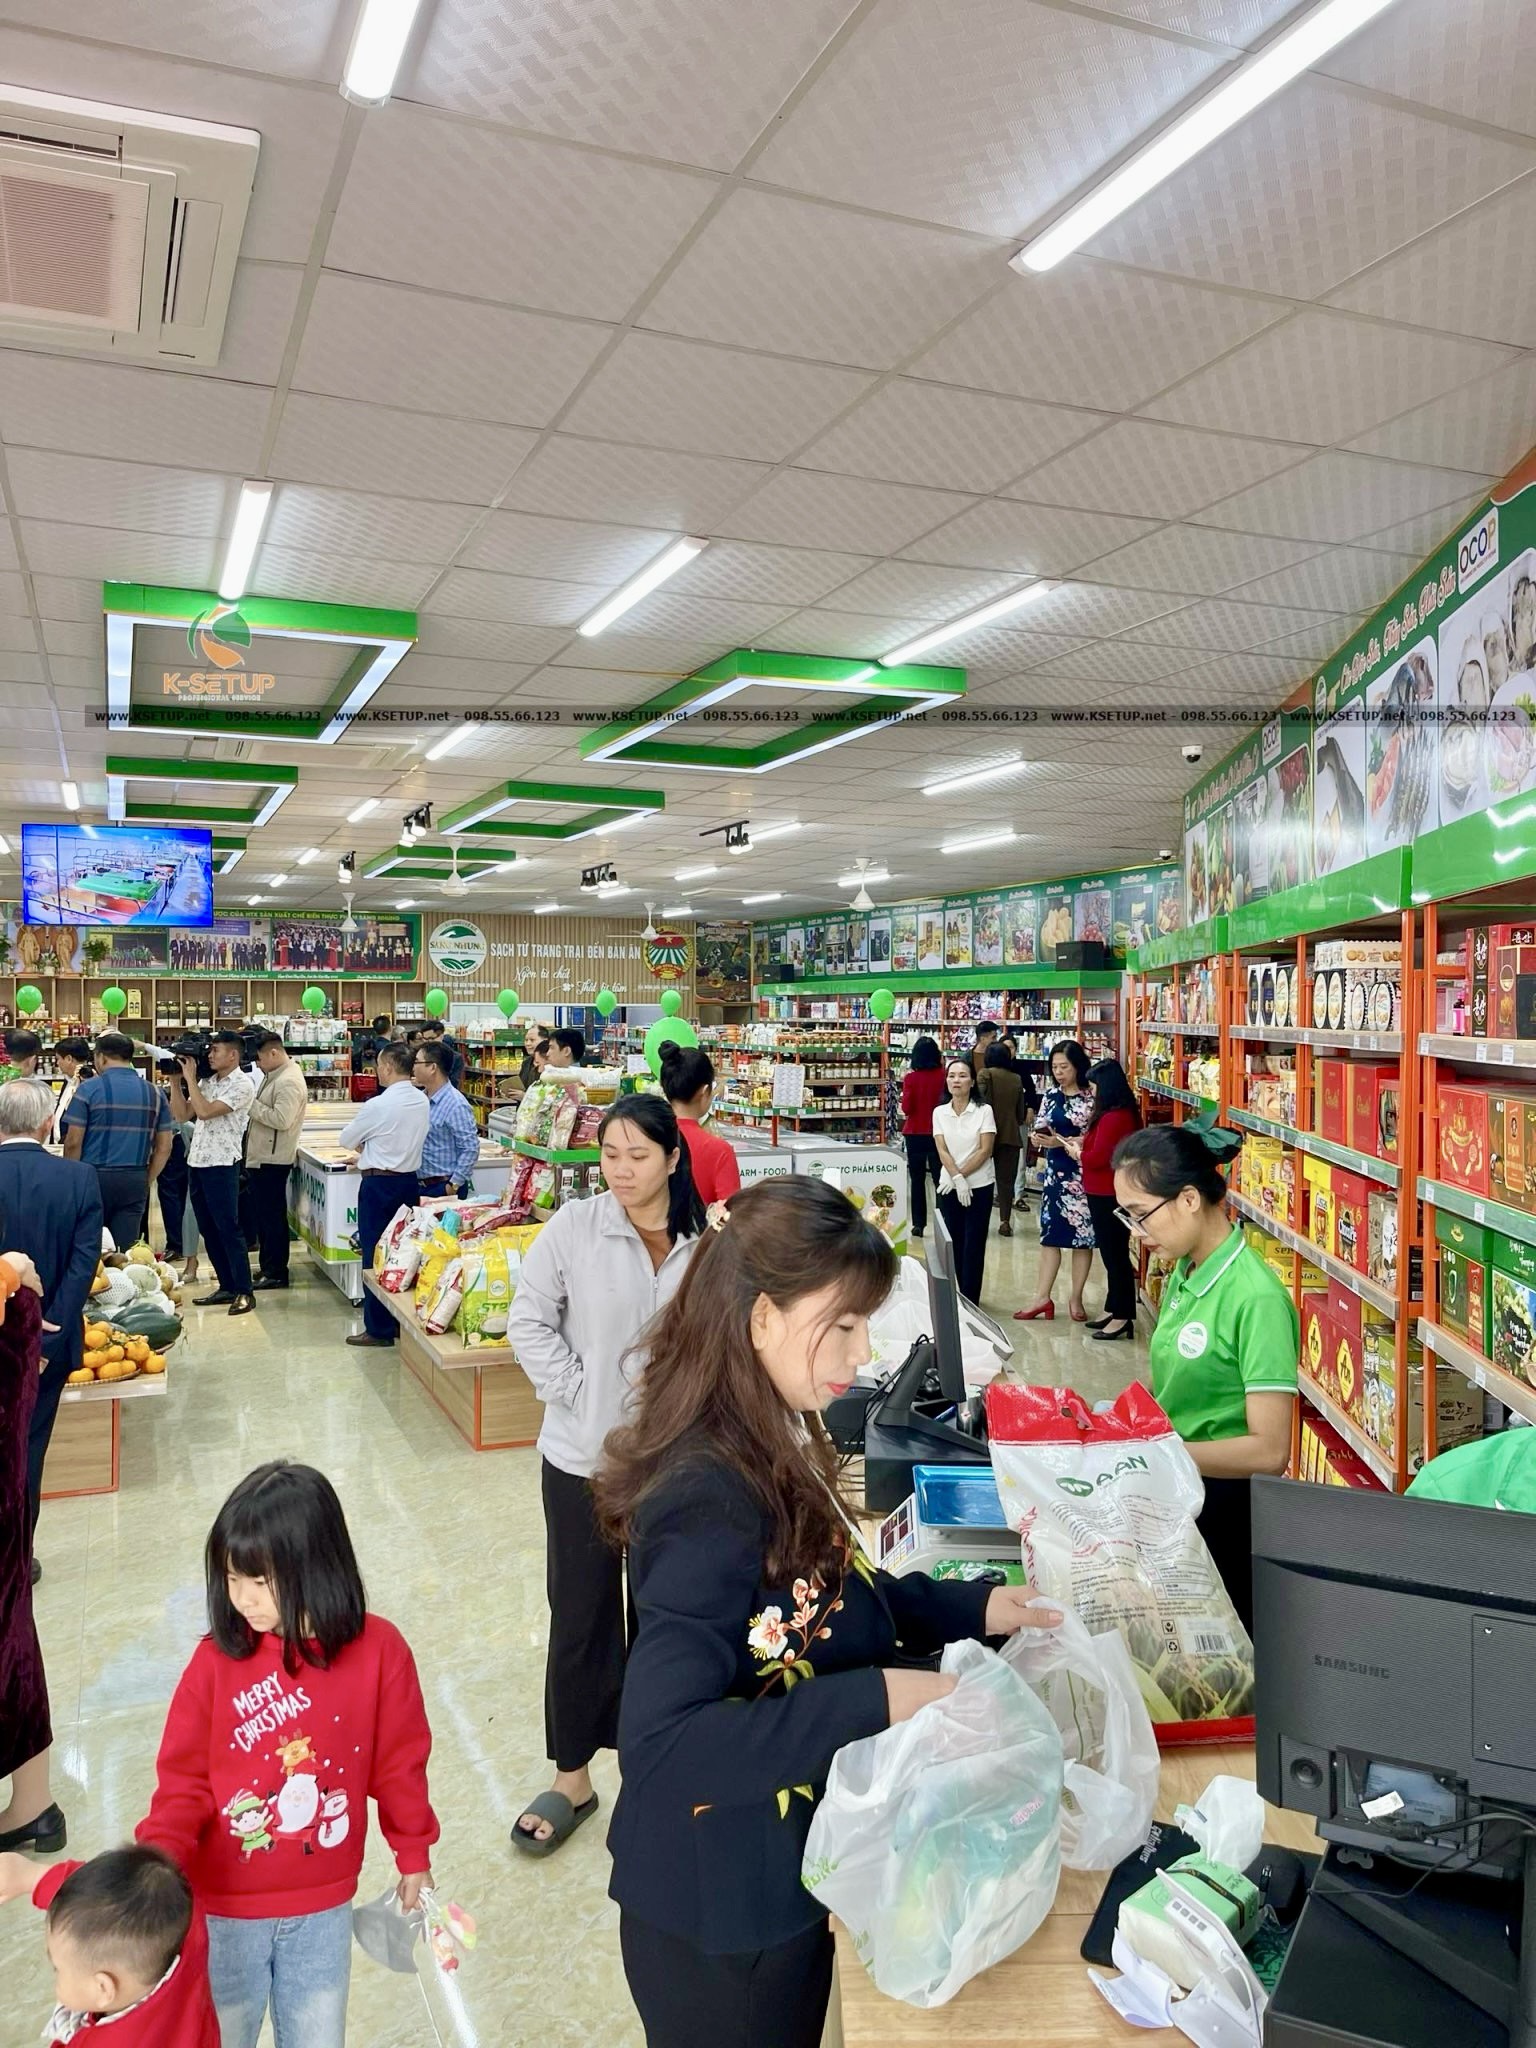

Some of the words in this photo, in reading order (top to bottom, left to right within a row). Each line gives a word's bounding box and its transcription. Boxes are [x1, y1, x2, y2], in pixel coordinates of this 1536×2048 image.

[1460, 517, 1496, 574] OCOP
[490, 943, 515, 959] SẠCH
[531, 944, 561, 958] TRANG
[563, 945, 584, 961] TRẠI
[587, 941, 605, 958] ĐẾN
[607, 942, 626, 959] BÀN
[740, 1169, 757, 1177] ARM
[764, 1168, 787, 1176] FOOD
[876, 1165, 898, 1175] SẠCH
[1314, 1654, 1390, 1680] SAMSUNG
[232, 1671, 283, 1719] MERRY
[233, 1687, 312, 1753] CHRISTMAS
